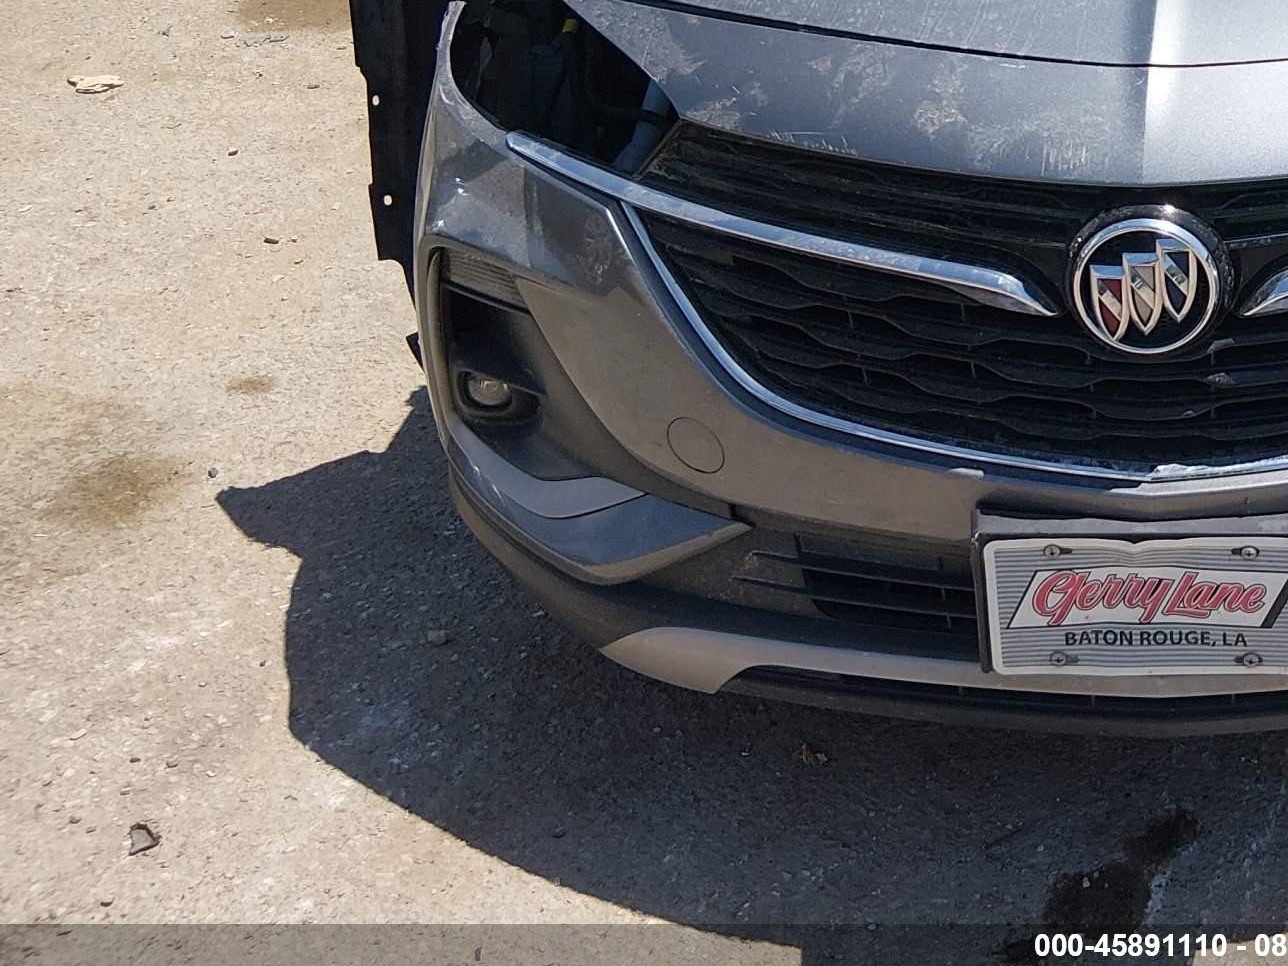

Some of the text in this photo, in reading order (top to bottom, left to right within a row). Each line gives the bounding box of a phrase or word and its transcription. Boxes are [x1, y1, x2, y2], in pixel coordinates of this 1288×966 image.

[1032, 570, 1267, 626] Gerry Lane
[1065, 629, 1248, 647] BATON ROUGE, LA
